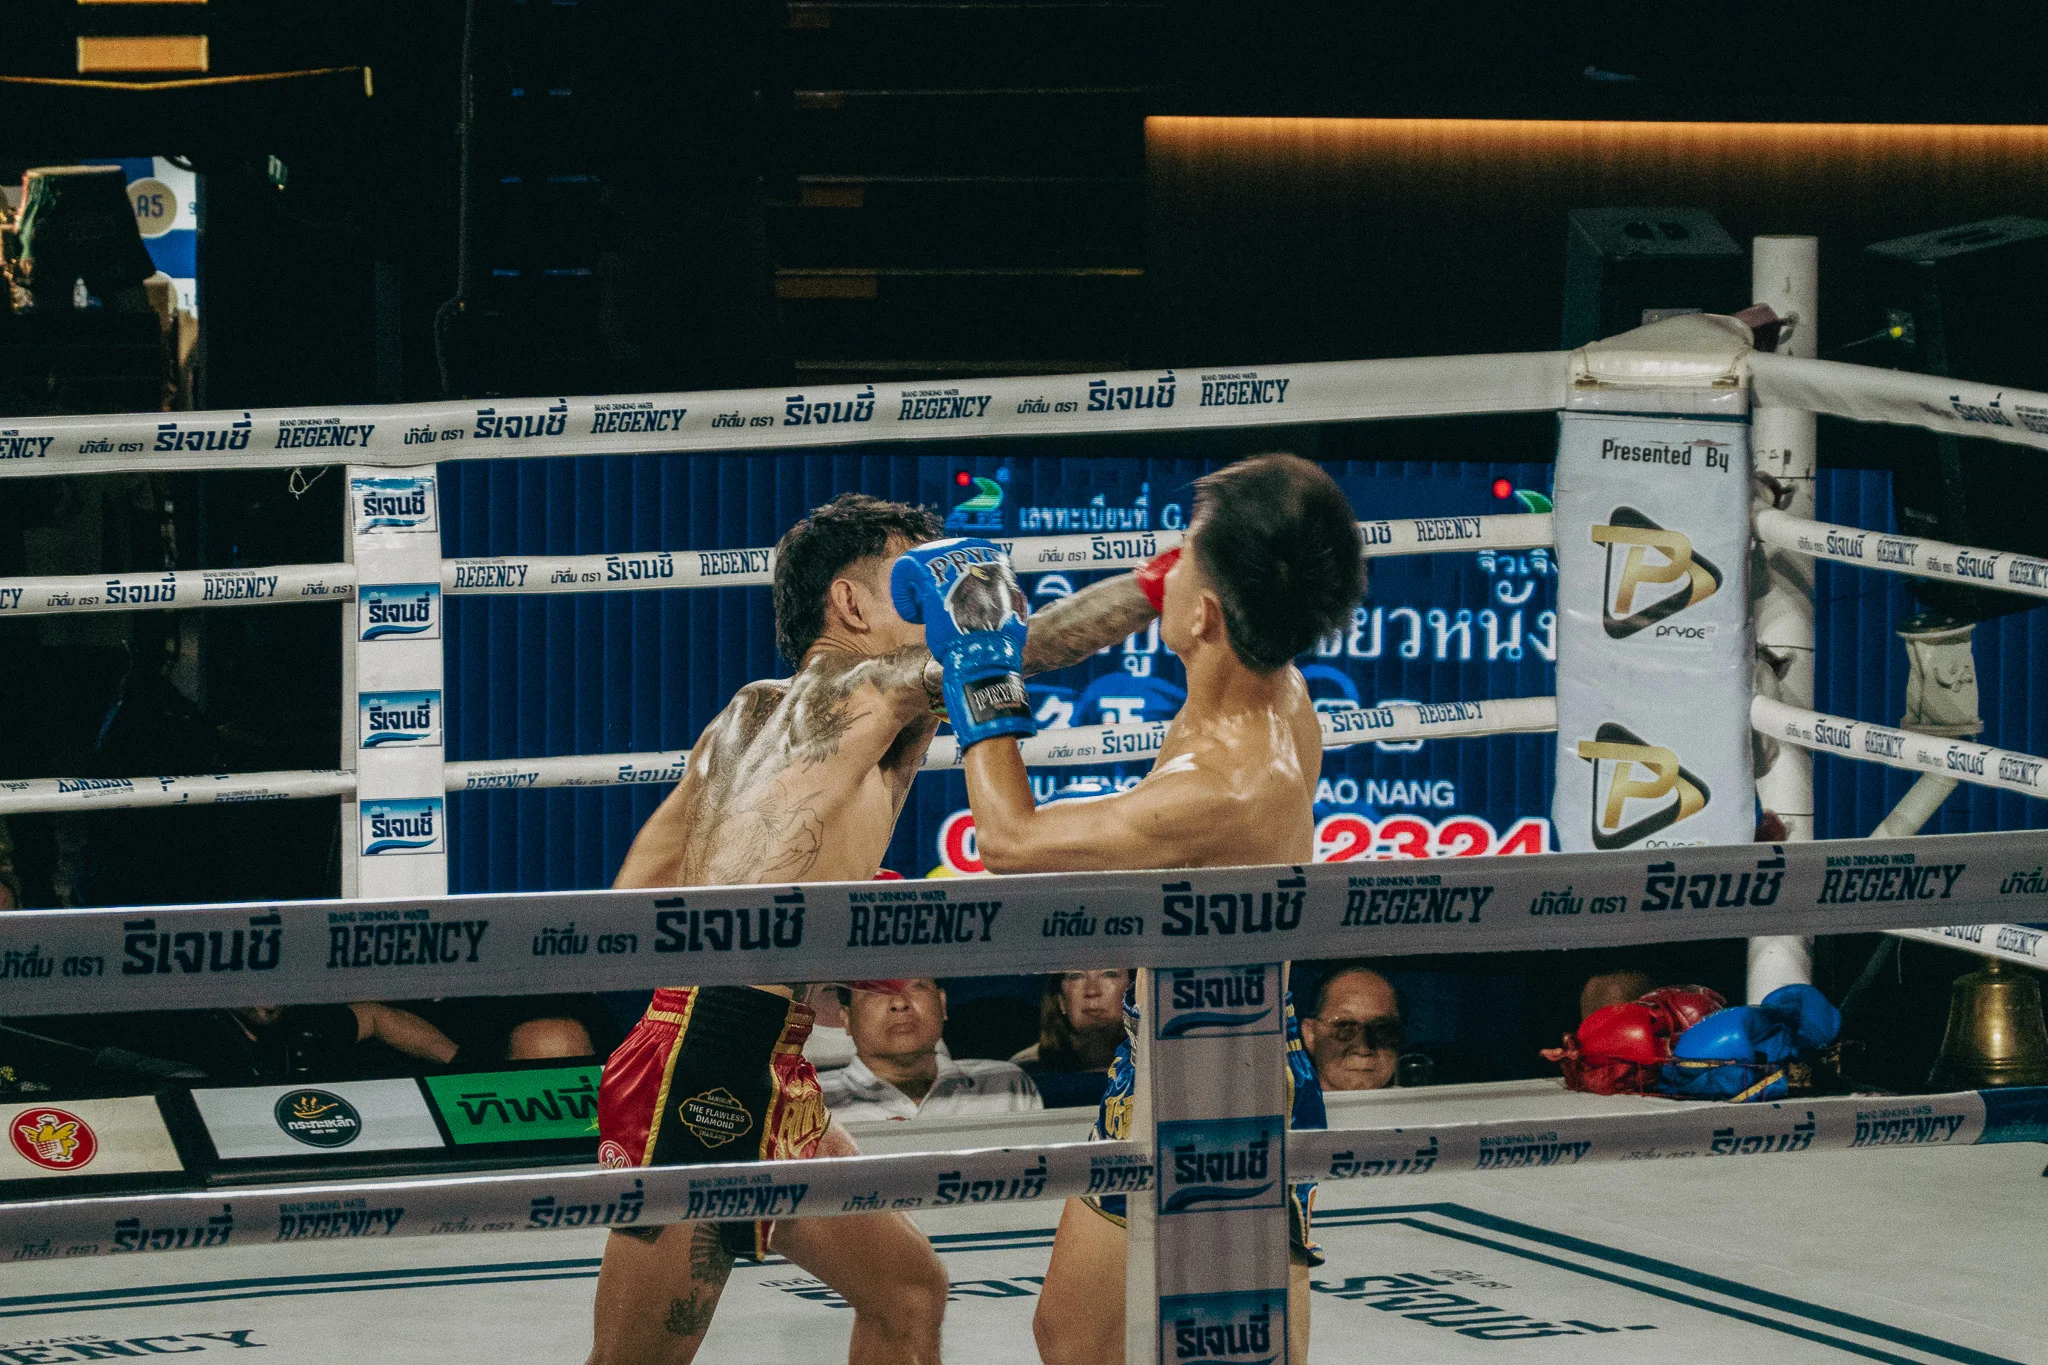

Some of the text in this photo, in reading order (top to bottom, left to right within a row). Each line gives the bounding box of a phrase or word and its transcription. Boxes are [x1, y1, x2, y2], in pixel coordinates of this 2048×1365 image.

[138, 194, 164, 218] A5
[1200, 379, 1290, 407] REGENCY
[897, 395, 992, 421] REGENCY
[591, 409, 687, 434] REGENCY
[275, 425, 375, 449] REGENCY
[1602, 438, 1729, 473] Presented By
[1415, 517, 1481, 542] REGENCY
[454, 564, 528, 588] REGENCY
[699, 550, 770, 576] REGENCY
[202, 575, 279, 600] REGENCY
[1417, 701, 1484, 724] REGENCY
[1367, 780, 1455, 807] NANG
[1817, 864, 1966, 904] REGENCY
[1341, 886, 1494, 926] REGENCY
[847, 901, 1001, 948] REGENCY
[326, 921, 489, 969] REGENCY
[689, 1104, 745, 1123] THE FLAWLESS
[695, 1115, 735, 1130] DIAMOND
[1849, 1114, 1965, 1148] REGENCY
[683, 1184, 809, 1220] REGENCY
